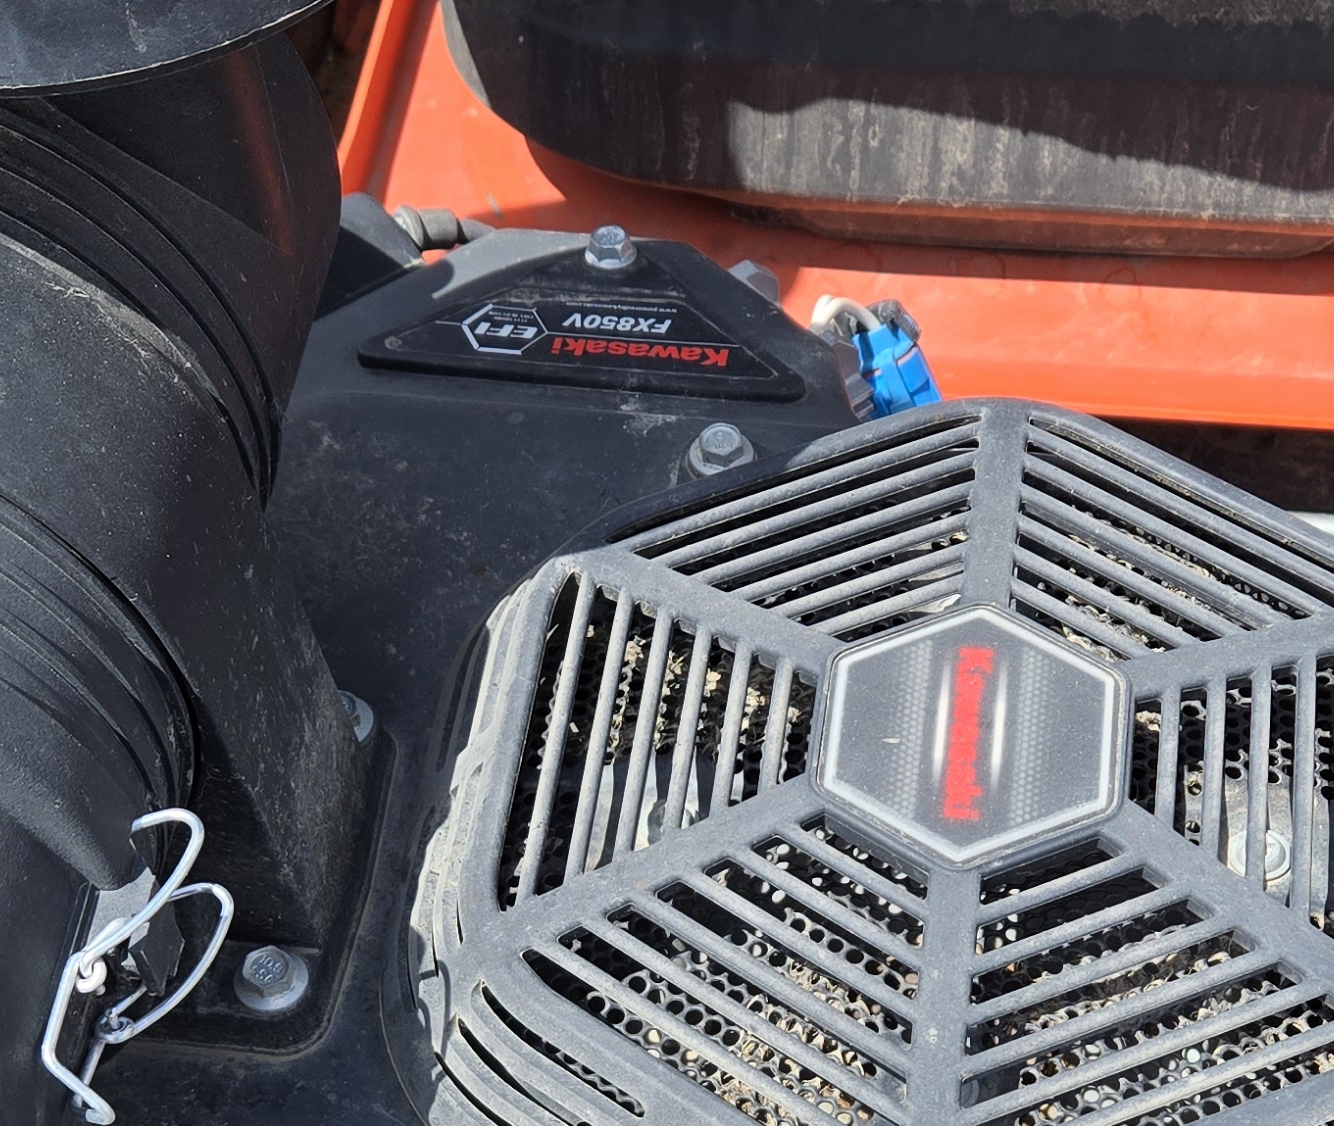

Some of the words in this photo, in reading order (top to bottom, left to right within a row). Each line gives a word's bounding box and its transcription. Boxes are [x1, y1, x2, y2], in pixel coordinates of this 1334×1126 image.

[474, 321, 538, 339] EFI
[562, 311, 672, 334] FX850V
[551, 336, 729, 367] Kawasaki
[942, 647, 995, 821] Kawasaki
